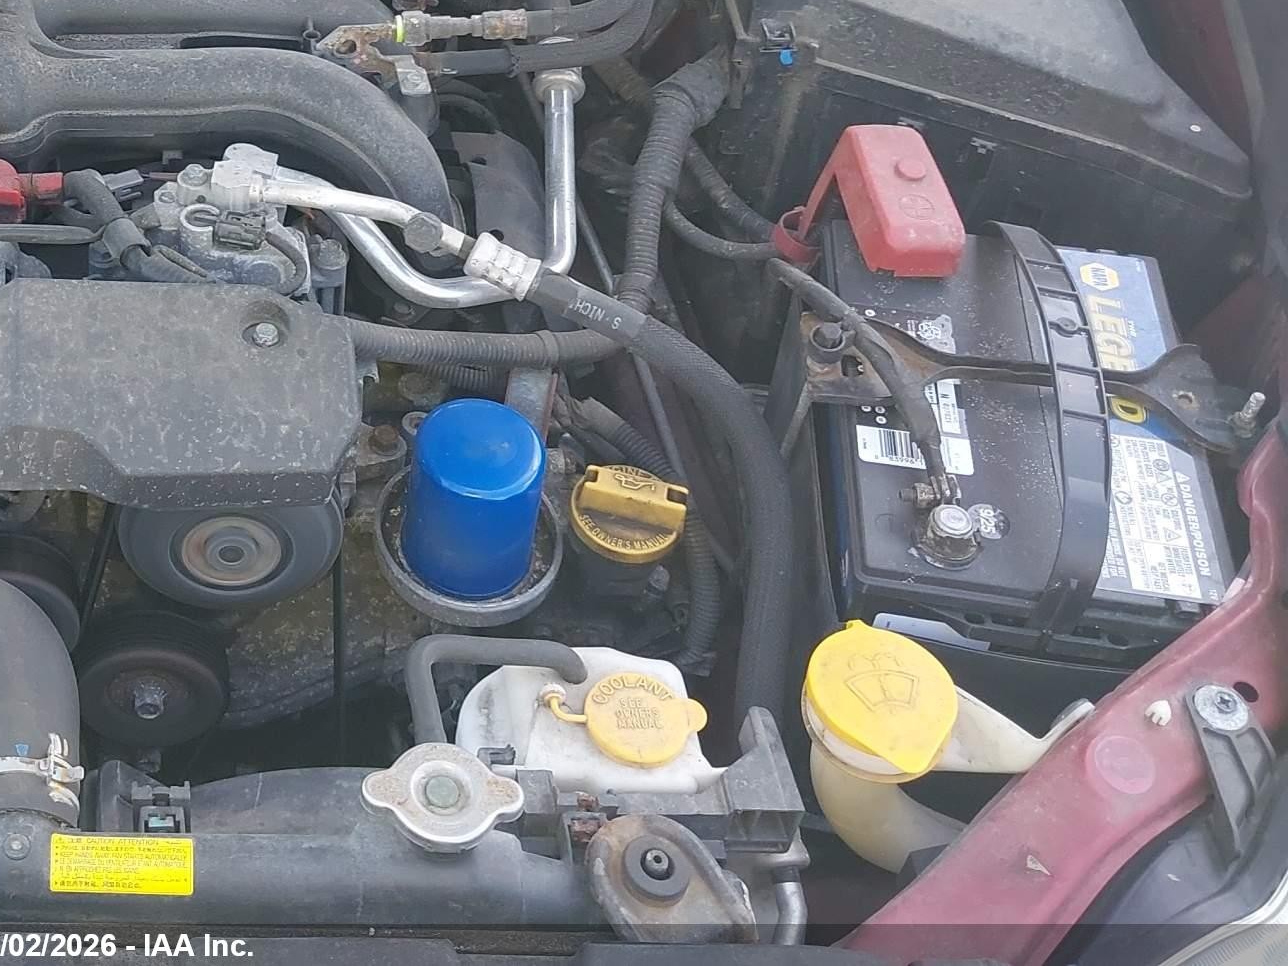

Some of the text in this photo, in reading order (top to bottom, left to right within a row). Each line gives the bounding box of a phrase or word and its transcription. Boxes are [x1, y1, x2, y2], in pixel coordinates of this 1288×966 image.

[1089, 266, 1109, 287] NAPA
[979, 507, 998, 535] 9/25
[1180, 483, 1211, 577] DANGER/POISON
[579, 514, 596, 530] SEE
[632, 533, 670, 550] MANUAL
[592, 675, 673, 704] COOLANT
[615, 707, 659, 718] OWNERS
[619, 698, 642, 708] SEE
[616, 717, 664, 729] MANUAL
[117, 838, 159, 846] ATTENTION
